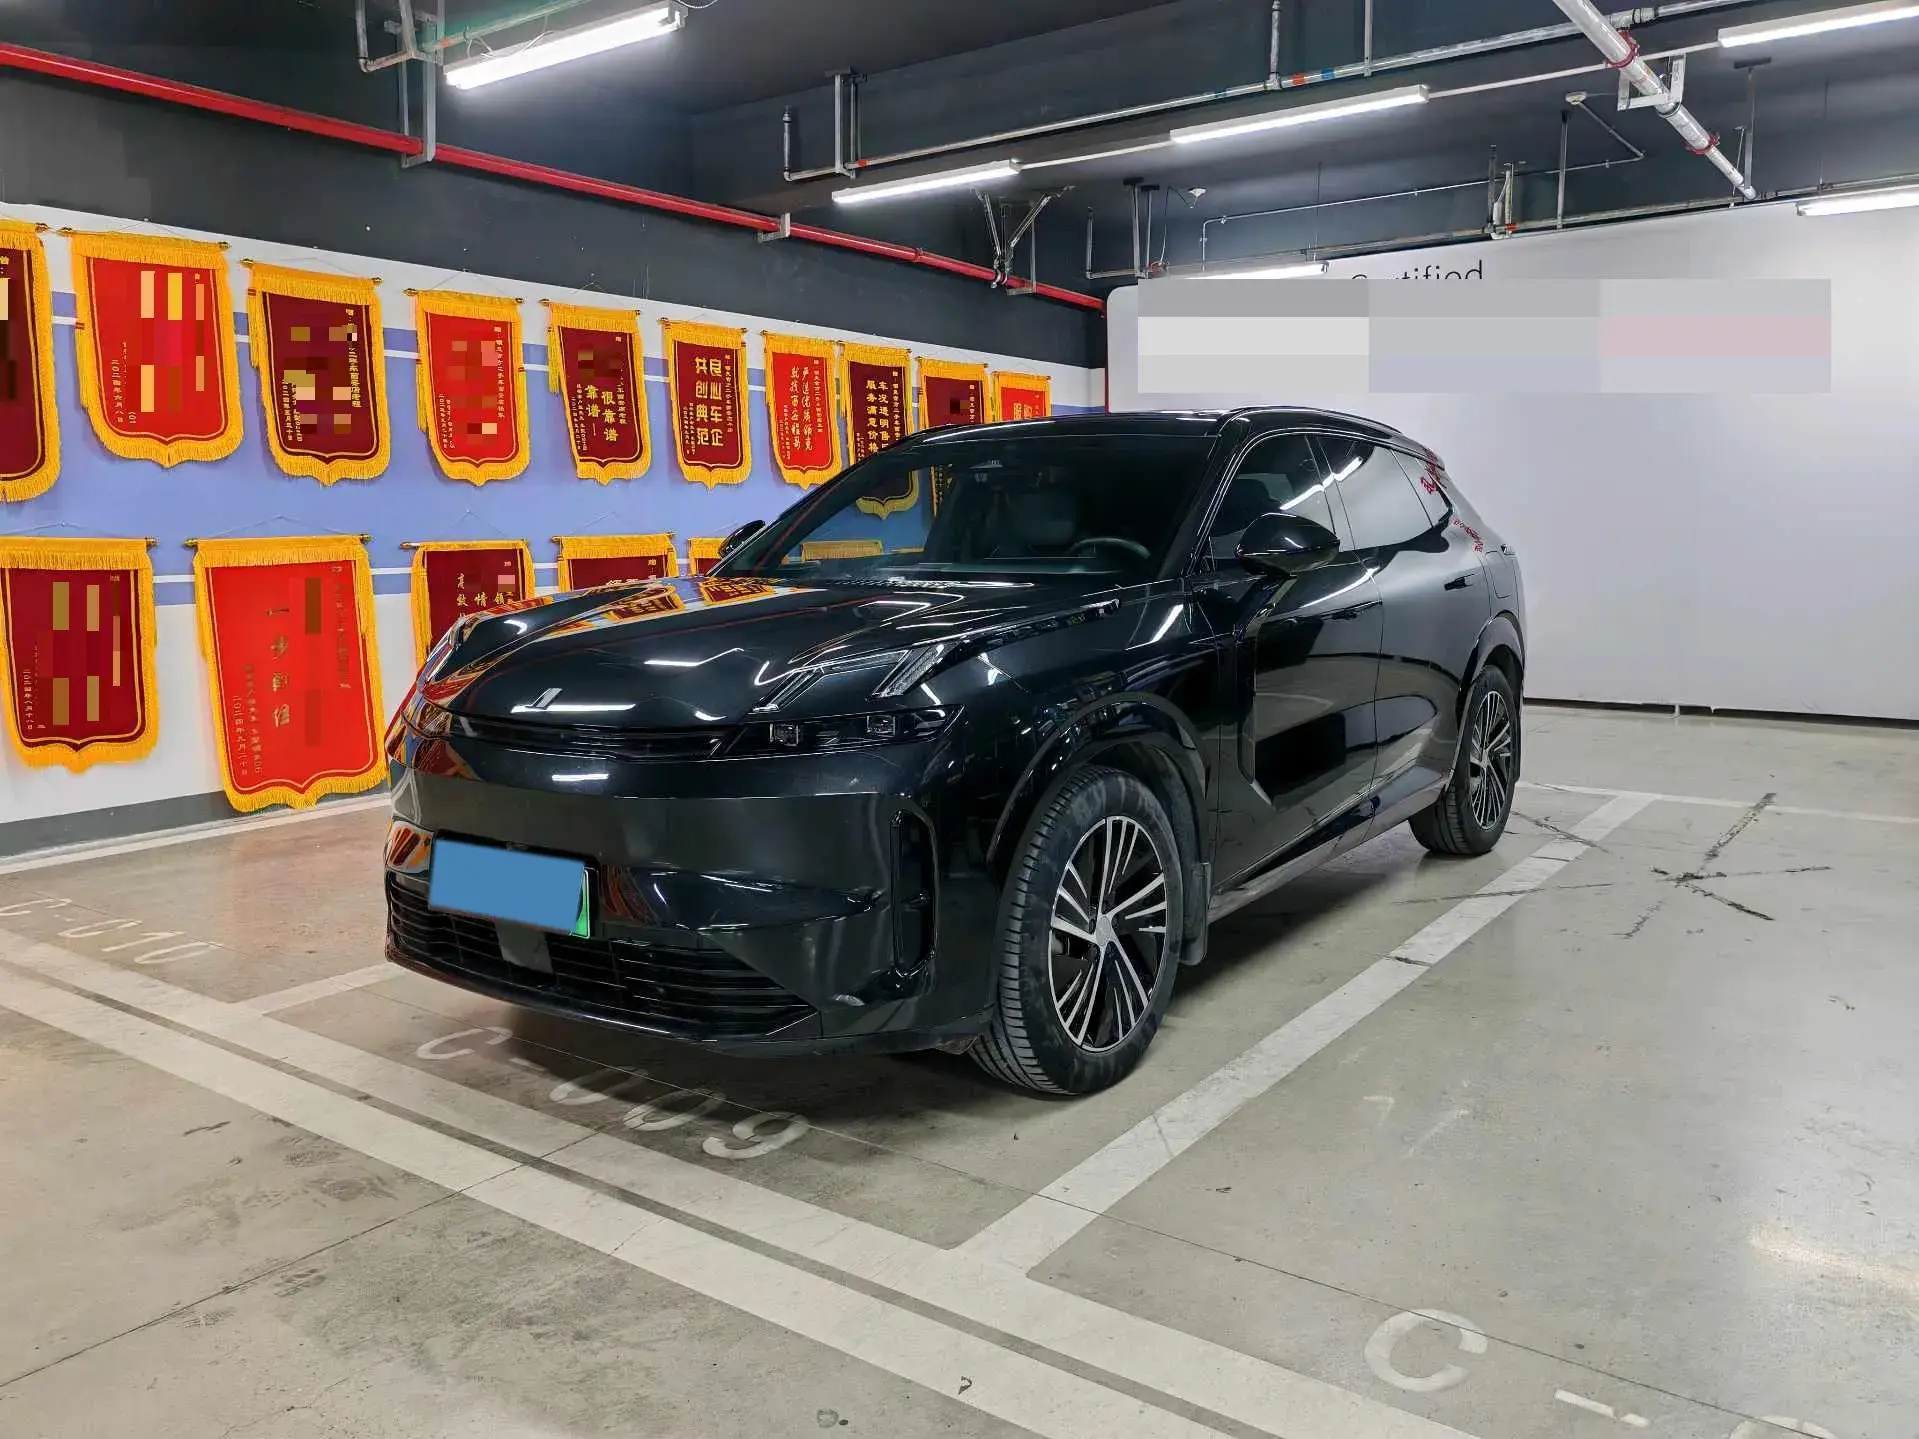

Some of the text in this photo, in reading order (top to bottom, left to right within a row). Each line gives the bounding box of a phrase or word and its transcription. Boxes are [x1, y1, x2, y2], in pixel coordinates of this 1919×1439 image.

[585, 384, 600, 436] 靠谱！
[601, 391, 619, 442] 很靠谱
[695, 356, 709, 446] 共创典范
[710, 358, 724, 446] 良心车企
[866, 379, 879, 453] 服务满意价格
[416, 1026, 810, 1160] C-009
